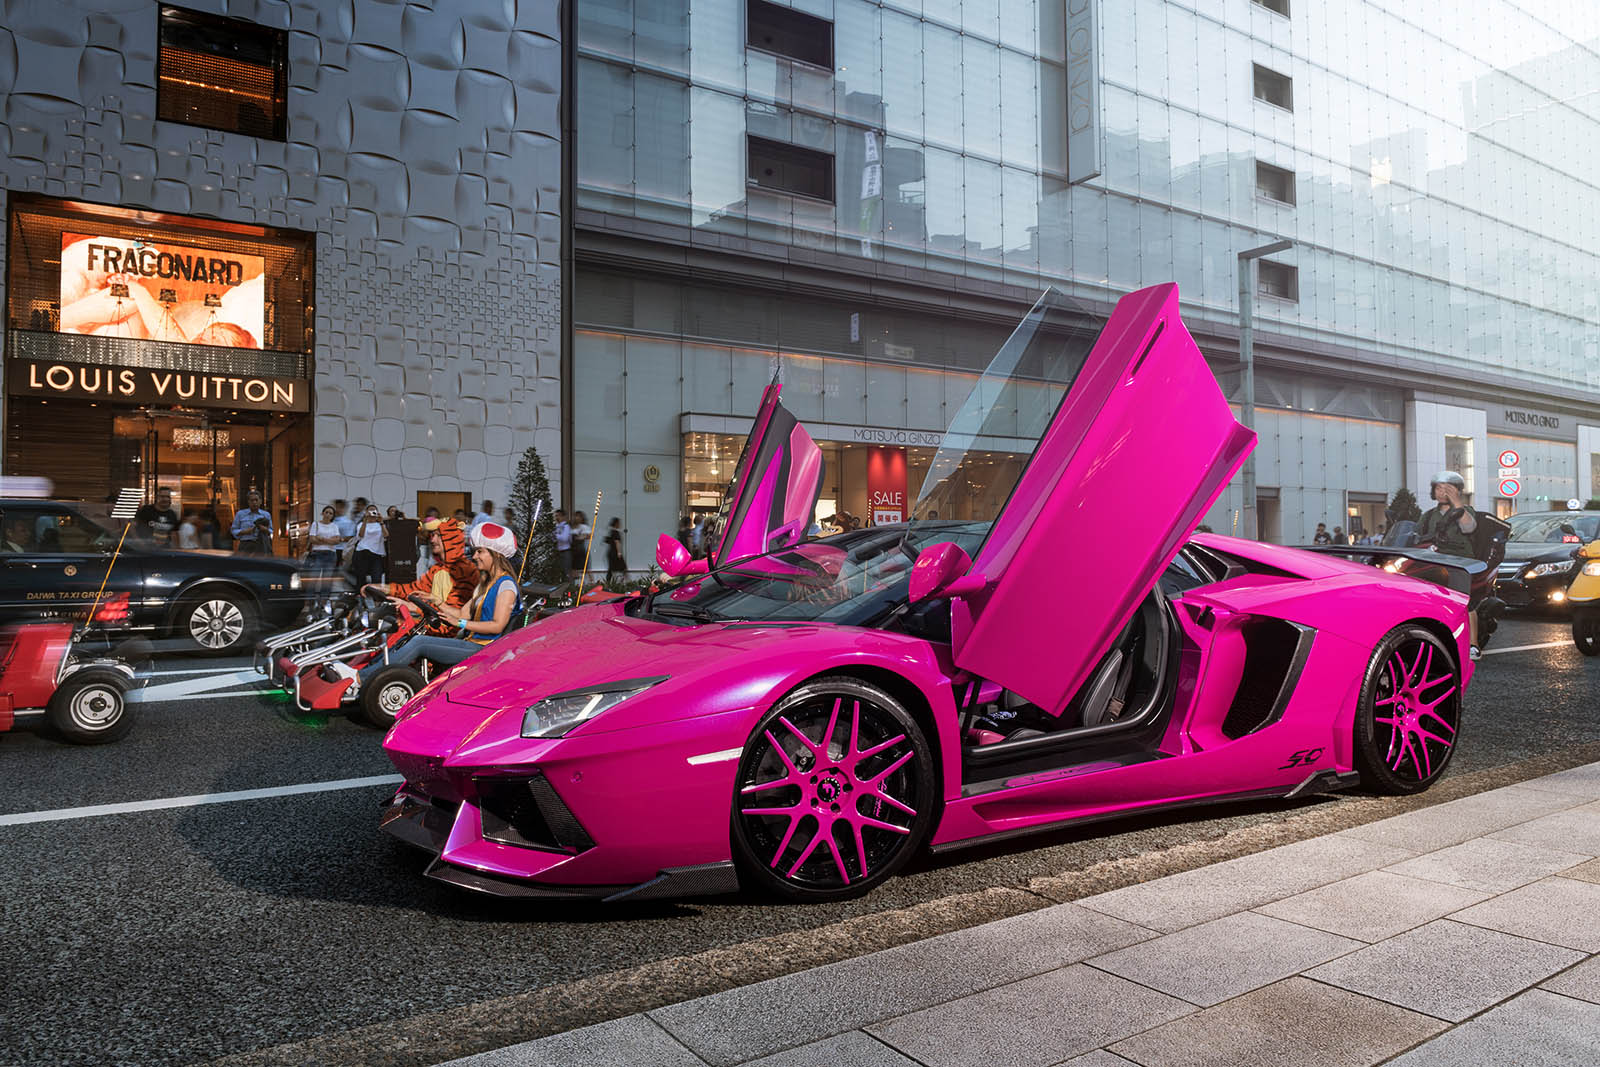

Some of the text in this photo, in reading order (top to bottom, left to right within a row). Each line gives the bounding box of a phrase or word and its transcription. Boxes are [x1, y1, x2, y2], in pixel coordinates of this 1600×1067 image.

[87, 243, 243, 287] FRAGONARD
[29, 364, 294, 404] LOUIS VUITTON
[873, 491, 902, 506] SALE
[26, 591, 114, 600] DAIWA TAXI GROUP
